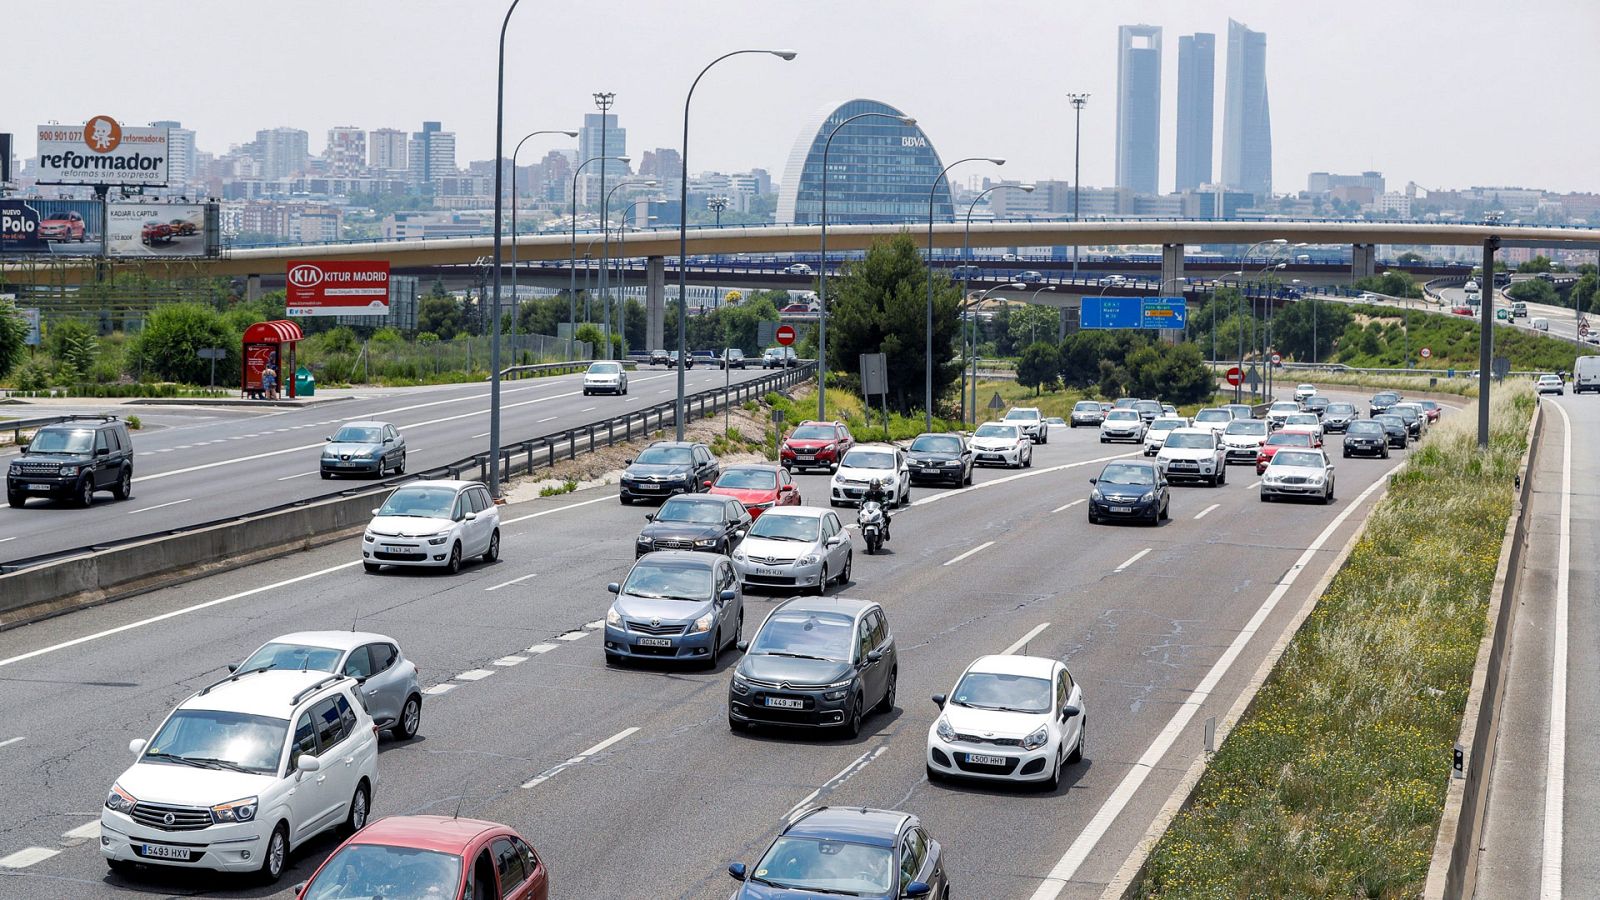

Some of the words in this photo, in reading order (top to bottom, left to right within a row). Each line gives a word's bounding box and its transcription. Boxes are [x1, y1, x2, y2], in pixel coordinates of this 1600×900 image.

[39, 131, 53, 141] 900
[54, 131, 67, 141] 901
[68, 131, 82, 141] 077
[123, 133, 165, 143] reformador.es
[902, 136, 926, 147] BBVA
[40, 151, 163, 170] reformador
[61, 169, 99, 178] reformas
[102, 169, 114, 178] sin
[117, 170, 159, 179] sorpresas
[2, 216, 35, 232] Polo
[294, 269, 318, 282] KIA
[324, 271, 351, 282] KITUR
[353, 271, 387, 282] MADRID
[770, 697, 787, 707] 1449
[788, 699, 802, 708] JWH
[970, 754, 989, 763] 4500
[989, 756, 1004, 765] HHY
[148, 846, 170, 857] 5493
[171, 848, 188, 859] HXV
